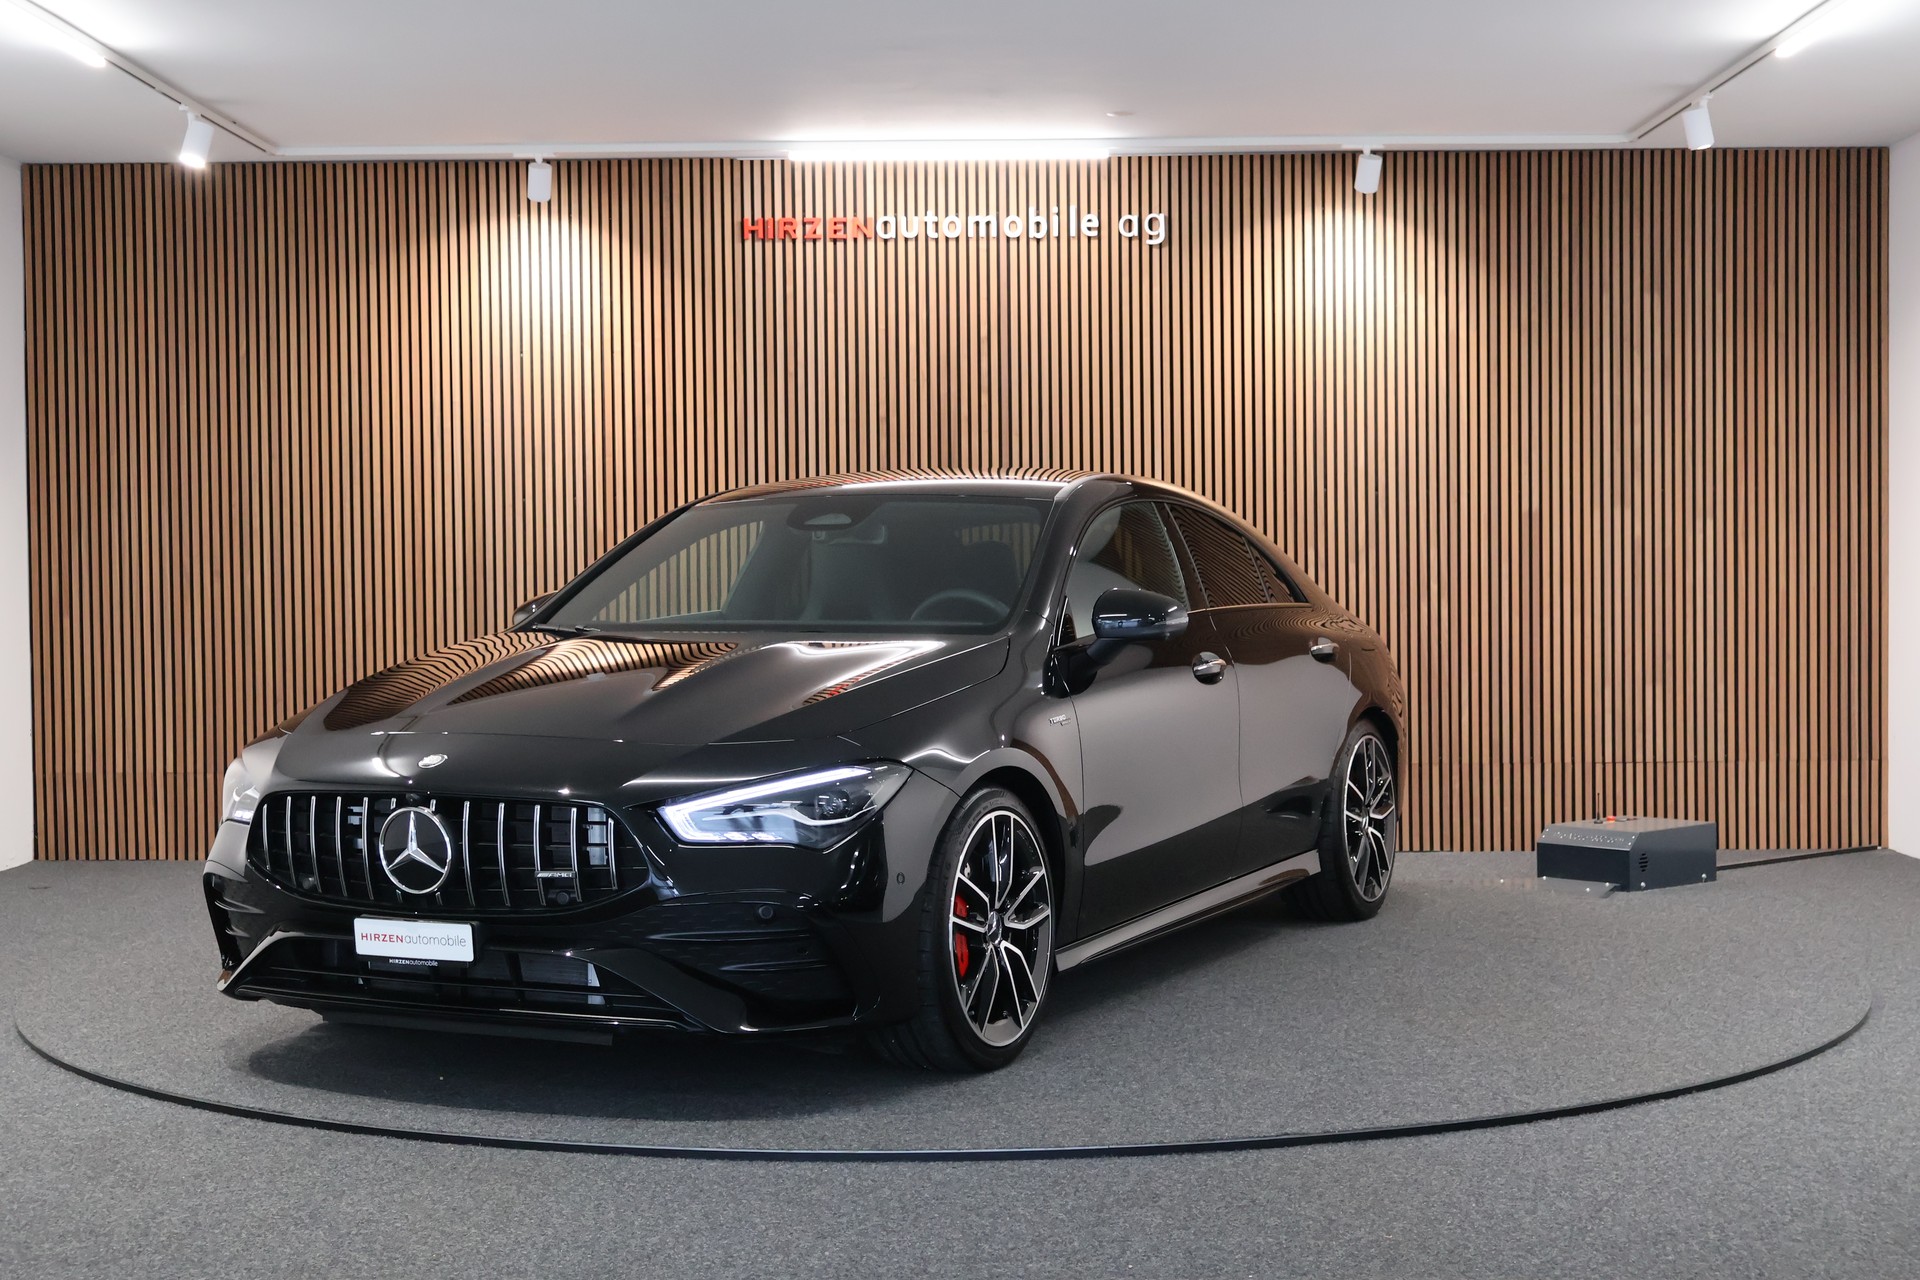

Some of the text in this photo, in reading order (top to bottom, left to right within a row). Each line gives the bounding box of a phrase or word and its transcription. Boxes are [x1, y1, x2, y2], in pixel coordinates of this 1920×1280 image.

[1118, 212, 1167, 245] ag
[360, 932, 467, 948] HIRZENautomobile
[388, 958, 438, 967] HIRZENautomobile
